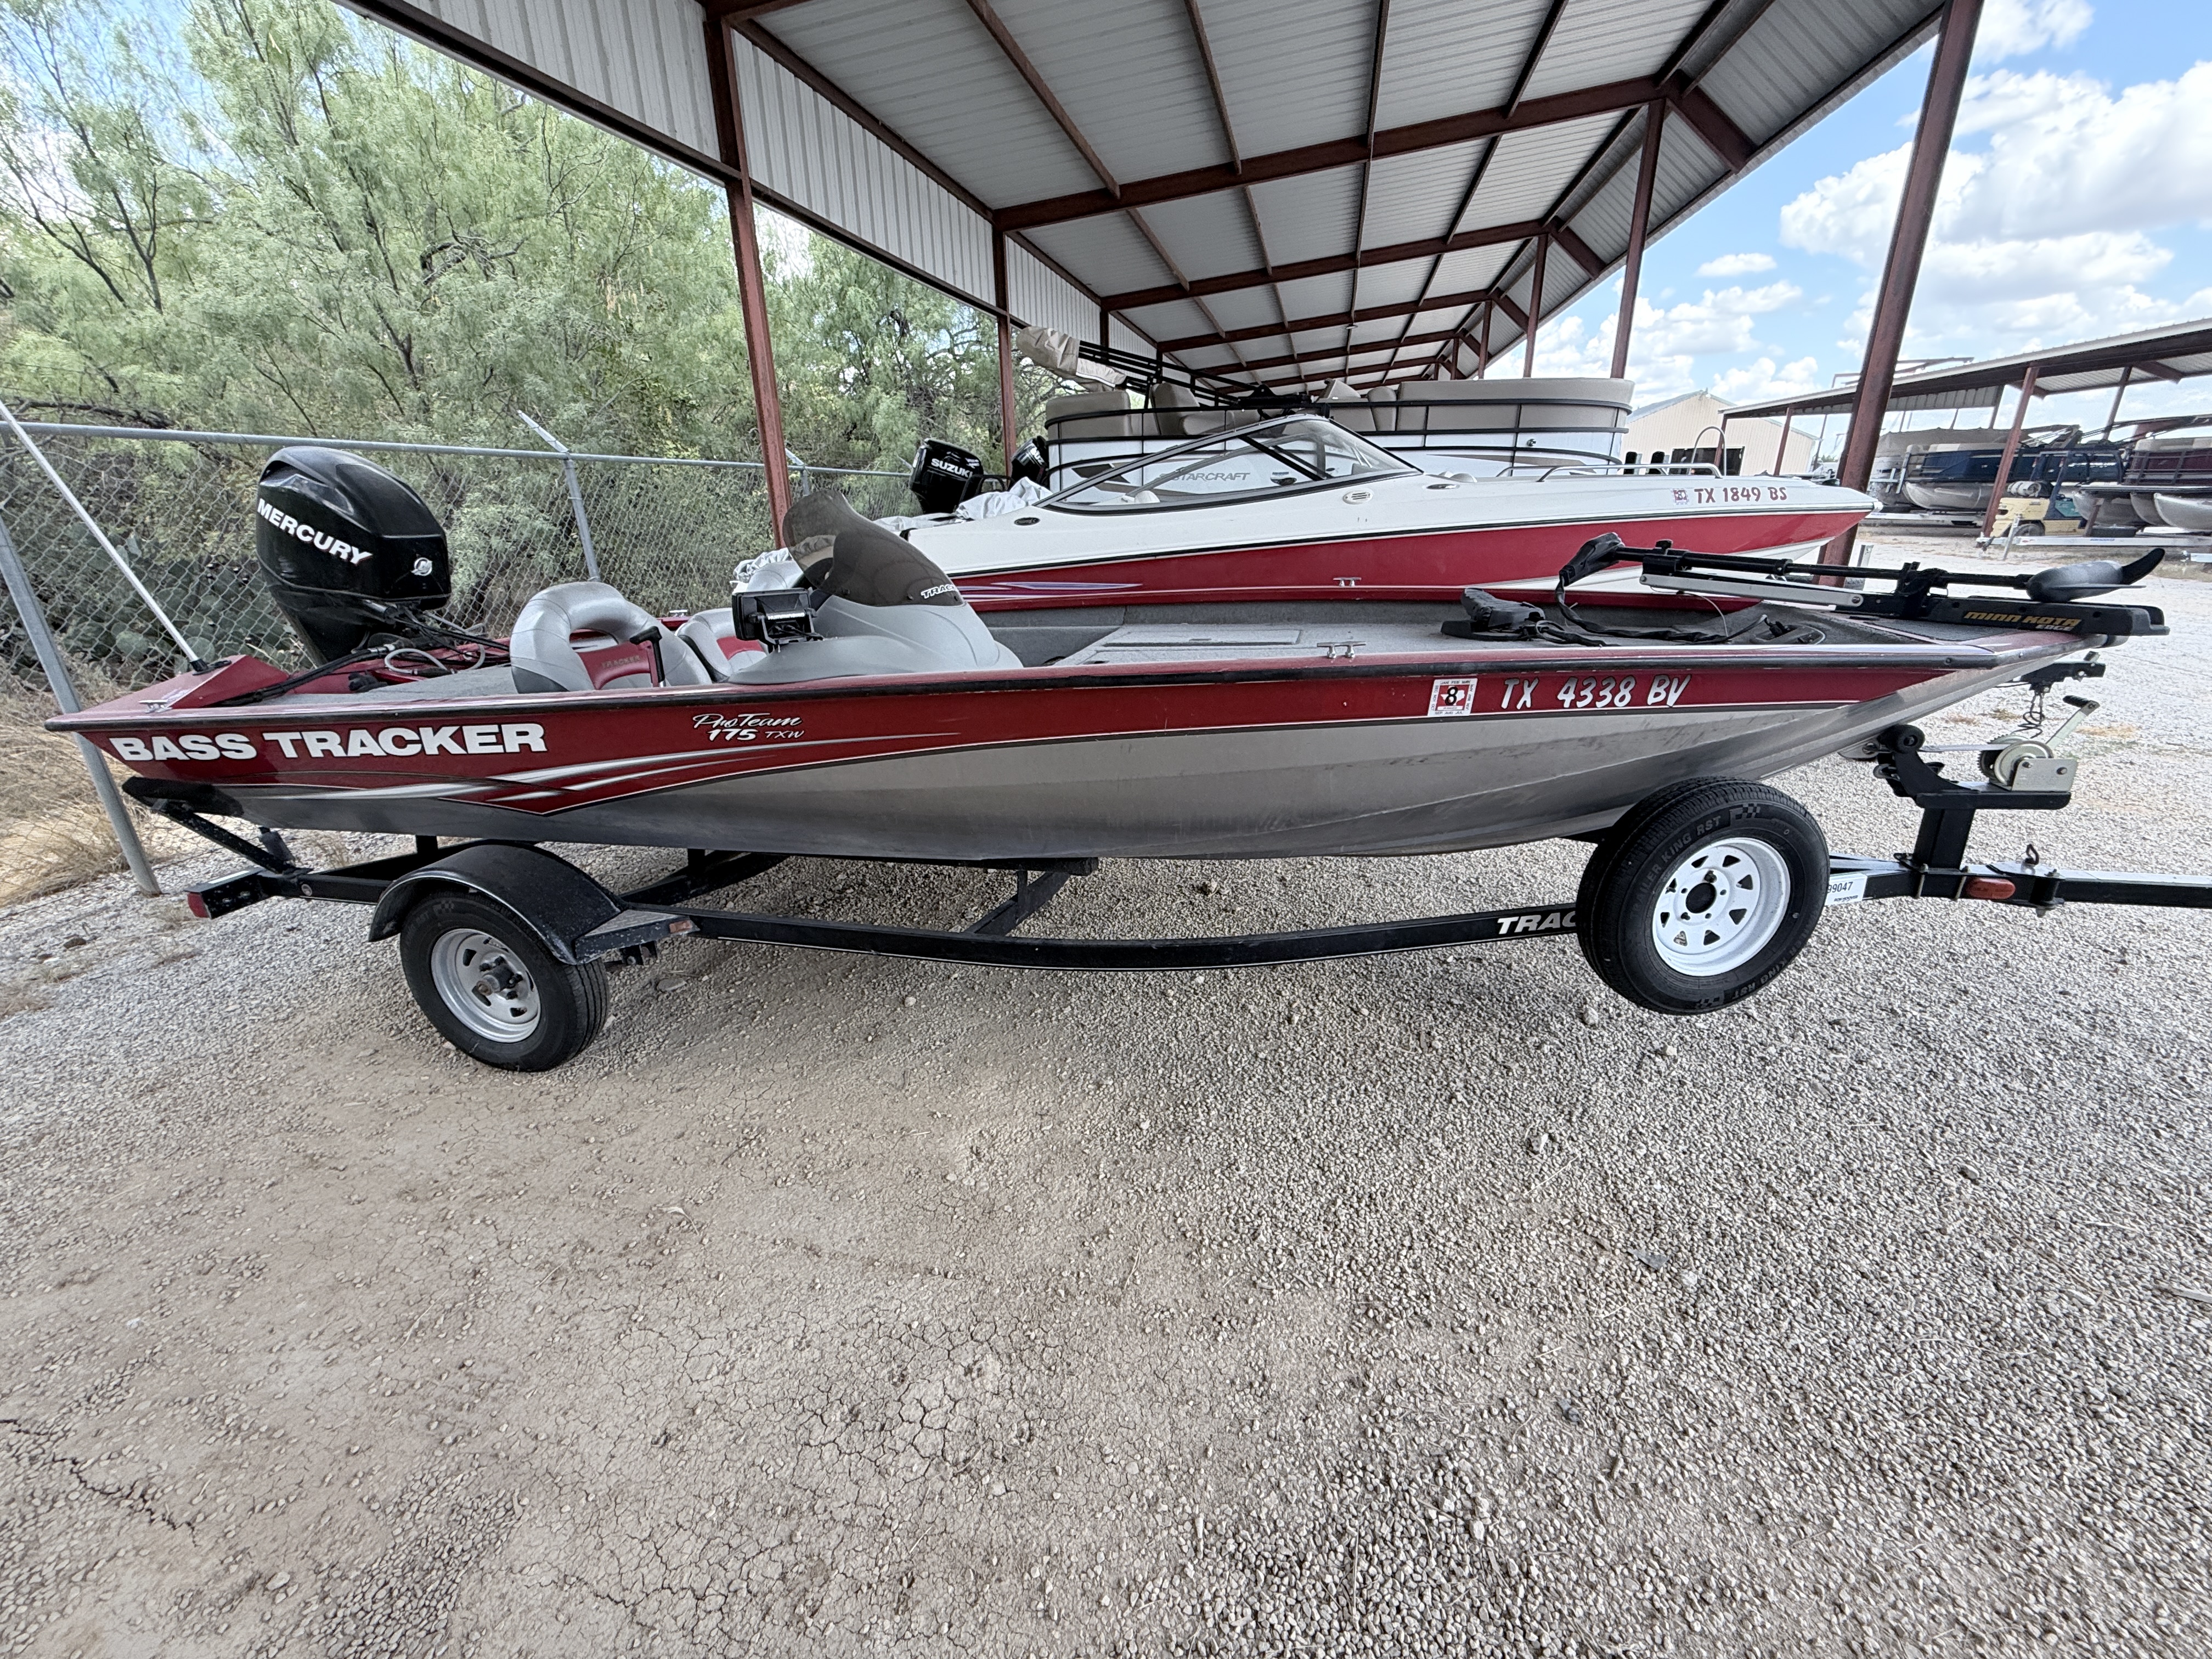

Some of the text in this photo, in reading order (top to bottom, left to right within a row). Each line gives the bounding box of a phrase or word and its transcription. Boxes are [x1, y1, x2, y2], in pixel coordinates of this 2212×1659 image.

[931, 458, 973, 477] SUZUKI
[1694, 487, 1787, 504] TX 1849 BS
[257, 498, 373, 566] MERCURY
[2022, 616, 2082, 627] KOTA
[1444, 686, 1458, 706] 8
[1500, 674, 1692, 709] TX 4338 BV
[109, 723, 548, 761] BASS TRACKER
[707, 729, 805, 741] 175 TXW
[1661, 833, 1692, 864] KING
[1696, 815, 1722, 836] RST
